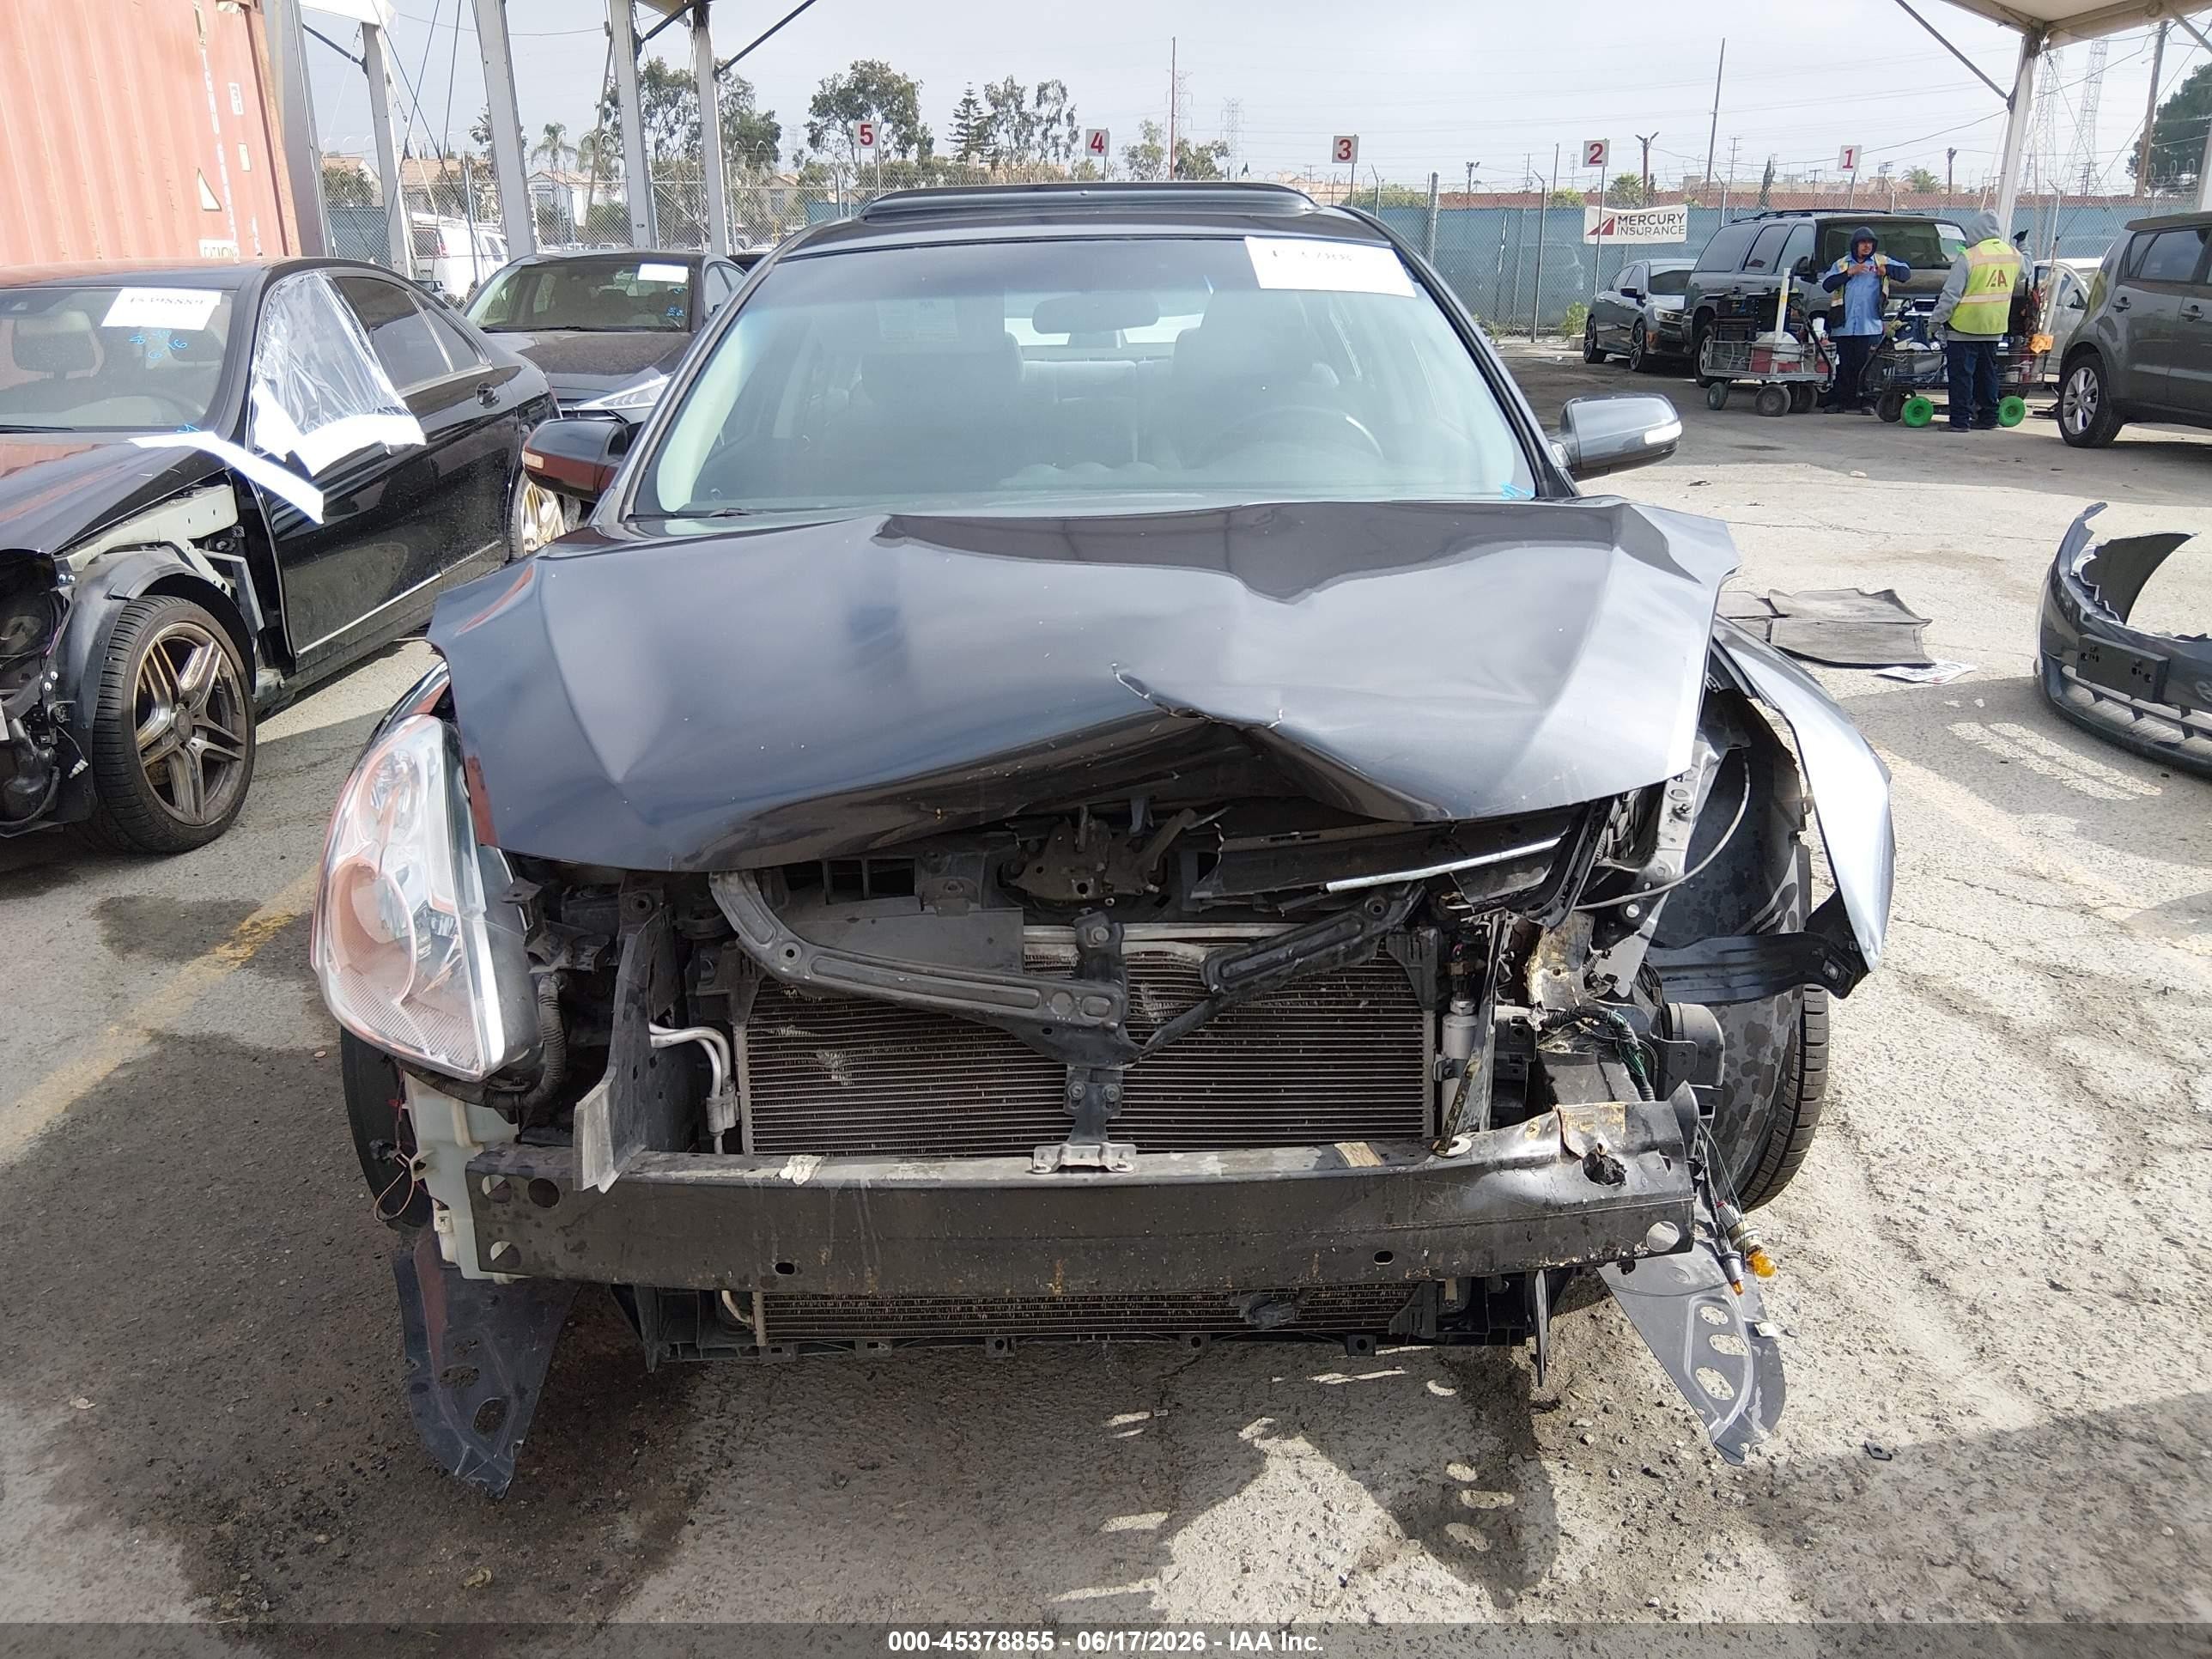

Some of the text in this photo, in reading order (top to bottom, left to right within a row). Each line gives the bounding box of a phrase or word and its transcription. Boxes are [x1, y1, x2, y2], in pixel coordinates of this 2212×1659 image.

[860, 124, 874, 146] 5
[1091, 131, 1104, 153] 4
[1337, 138, 1352, 161] 3
[1589, 143, 1603, 164] 2
[1842, 148, 1853, 168] 1
[1618, 212, 1686, 226] MERCURY
[1616, 225, 1686, 236] INSURANCE
